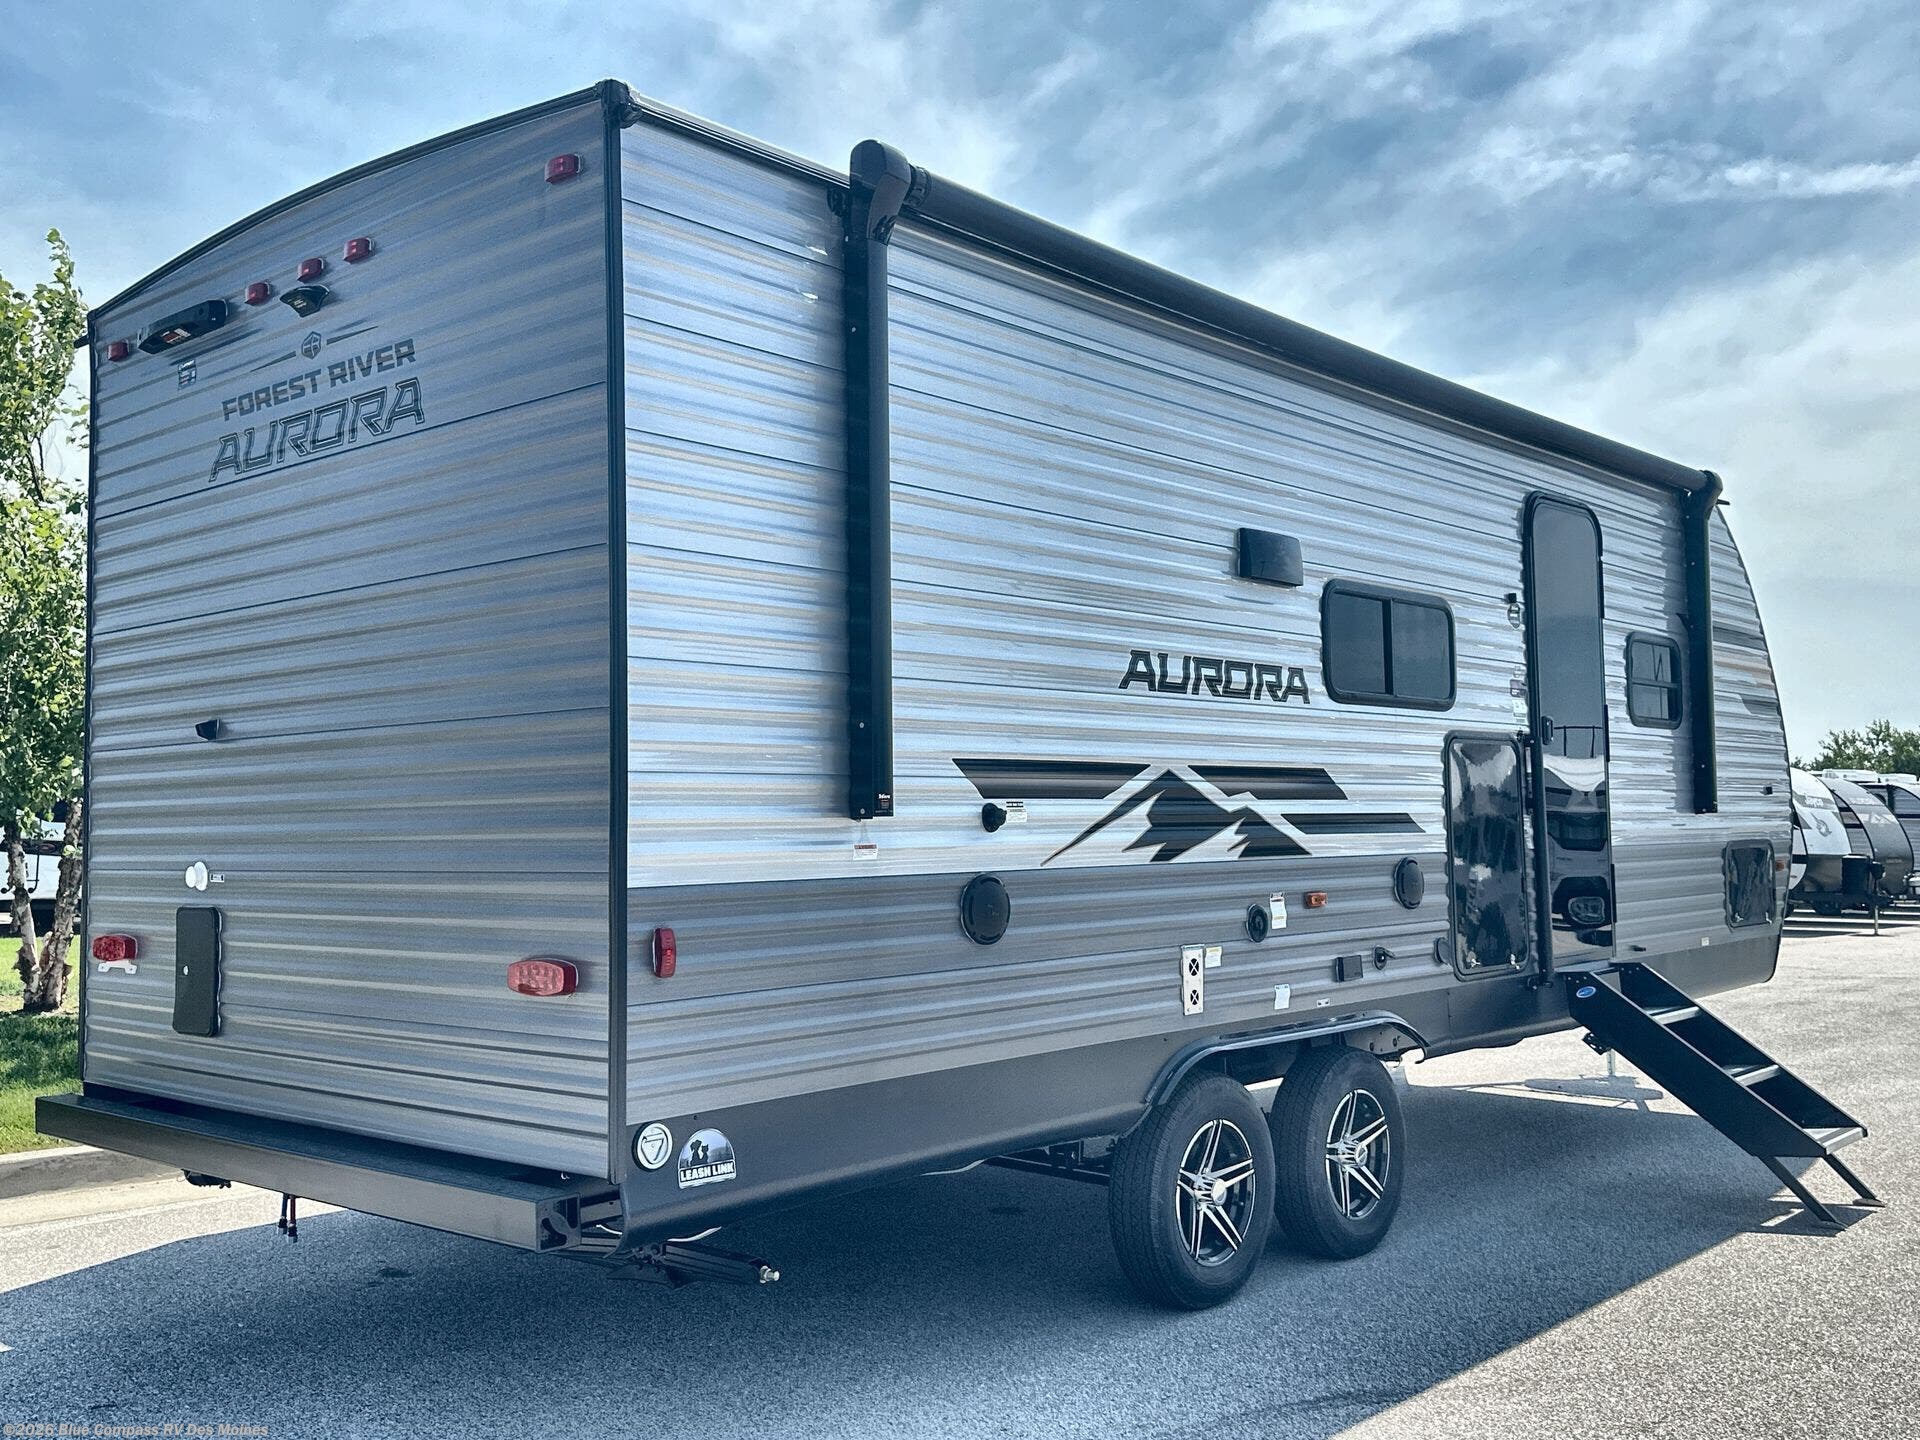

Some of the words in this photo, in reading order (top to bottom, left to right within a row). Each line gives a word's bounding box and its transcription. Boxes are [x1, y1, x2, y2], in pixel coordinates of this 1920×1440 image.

[221, 368, 322, 422] FOREST
[327, 338, 417, 388] RIVER
[208, 377, 425, 482] AURORA
[1118, 649, 1310, 705] AURORA
[681, 1168, 711, 1181] LEASH
[713, 1162, 734, 1175] LINK
